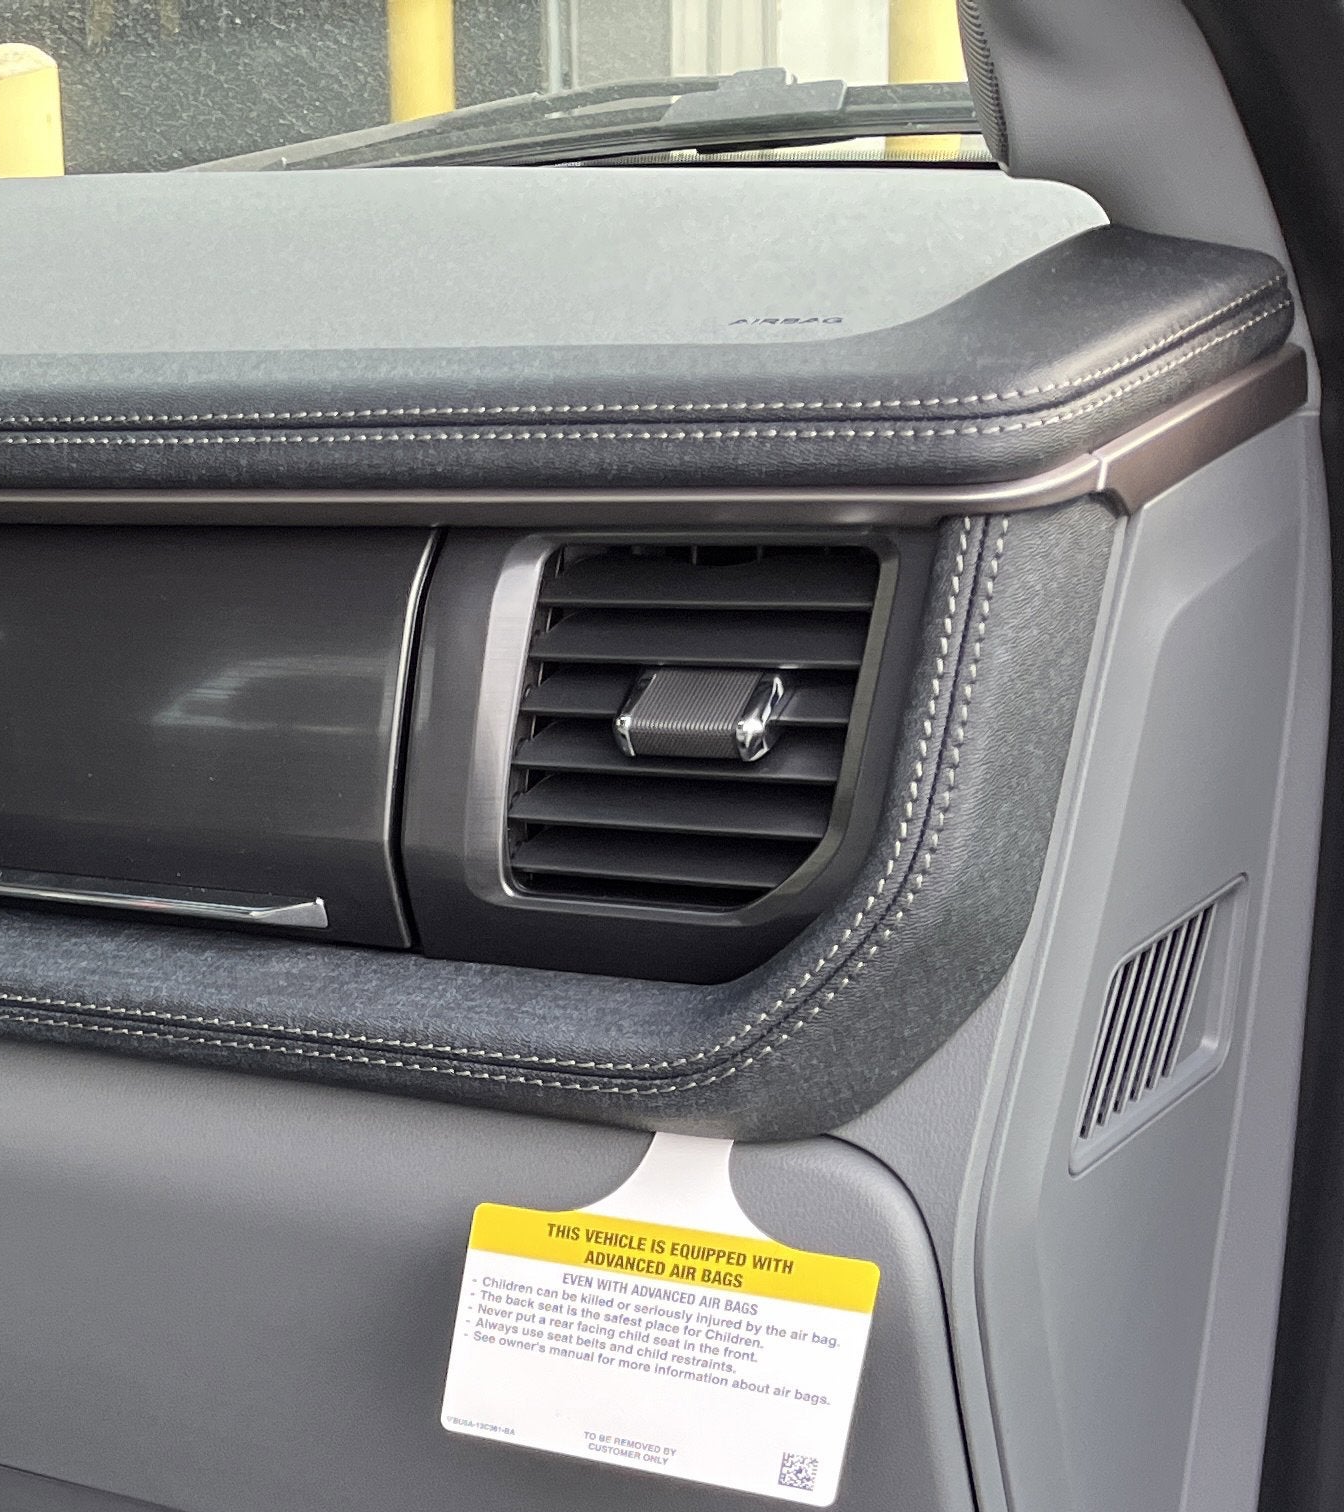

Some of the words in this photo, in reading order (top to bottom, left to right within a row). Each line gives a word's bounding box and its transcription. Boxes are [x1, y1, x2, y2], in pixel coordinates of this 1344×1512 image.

[547, 1222, 581, 1241] THIS
[585, 1228, 647, 1251] VEHICLE
[650, 1238, 666, 1255] IS
[669, 1241, 747, 1267] EQUIPPED
[752, 1254, 794, 1275] WITH
[584, 1250, 666, 1276] ADVANCED
[669, 1263, 697, 1281] AIR
[701, 1268, 744, 1288] BAGS
[480, 1289, 503, 1304] The
[505, 1293, 535, 1309] back
[537, 1301, 564, 1315] seat
[566, 1304, 578, 1317] is
[581, 1307, 601, 1321] the
[603, 1312, 643, 1328] safest
[645, 1319, 680, 1334] place
[683, 1324, 703, 1338] for
[705, 1328, 764, 1349] Children.
[482, 1276, 533, 1295] Children
[536, 1286, 559, 1299] can
[561, 1289, 578, 1302] be
[580, 1292, 615, 1308] killed
[617, 1301, 631, 1311] or
[633, 1303, 694, 1324] seriously
[696, 1312, 743, 1330] injured
[745, 1320, 763, 1336] by
[765, 1324, 787, 1338] the
[790, 1329, 809, 1342] air
[811, 1331, 841, 1349] bag.
[562, 1272, 594, 1289] EVEN
[597, 1278, 629, 1295] WITH
[631, 1284, 696, 1306] ADVANCED
[698, 1295, 721, 1310] AIR
[724, 1299, 759, 1316] BAGS
[475, 1317, 519, 1336] Always
[521, 1328, 544, 1339] use
[547, 1331, 574, 1345] seat
[576, 1335, 607, 1350] belts
[609, 1342, 634, 1355] and
[636, 1346, 669, 1361] child
[671, 1354, 736, 1374] restraints.
[477, 1303, 514, 1319] Never
[515, 1311, 536, 1324] put
[538, 1316, 546, 1325] a
[549, 1317, 575, 1330] rear
[577, 1320, 616, 1340] facing
[618, 1329, 650, 1344] child
[653, 1335, 681, 1350] seat
[683, 1339, 696, 1352] in
[699, 1342, 720, 1356] the
[723, 1346, 758, 1363] front.
[473, 1330, 496, 1344] See
[498, 1336, 546, 1353] owner's
[549, 1345, 595, 1362] manual
[597, 1352, 616, 1365] for
[618, 1359, 651, 1373] more
[654, 1362, 729, 1387] information
[731, 1379, 770, 1395] about
[773, 1385, 792, 1398] air
[794, 1388, 831, 1406] bags.
[584, 1431, 597, 1441] TO
[598, 1434, 612, 1444] BE
[613, 1437, 661, 1454] REMOVED
[663, 1447, 677, 1457] BY
[588, 1442, 641, 1460] CUSTOMER
[643, 1453, 669, 1466] ONLY
